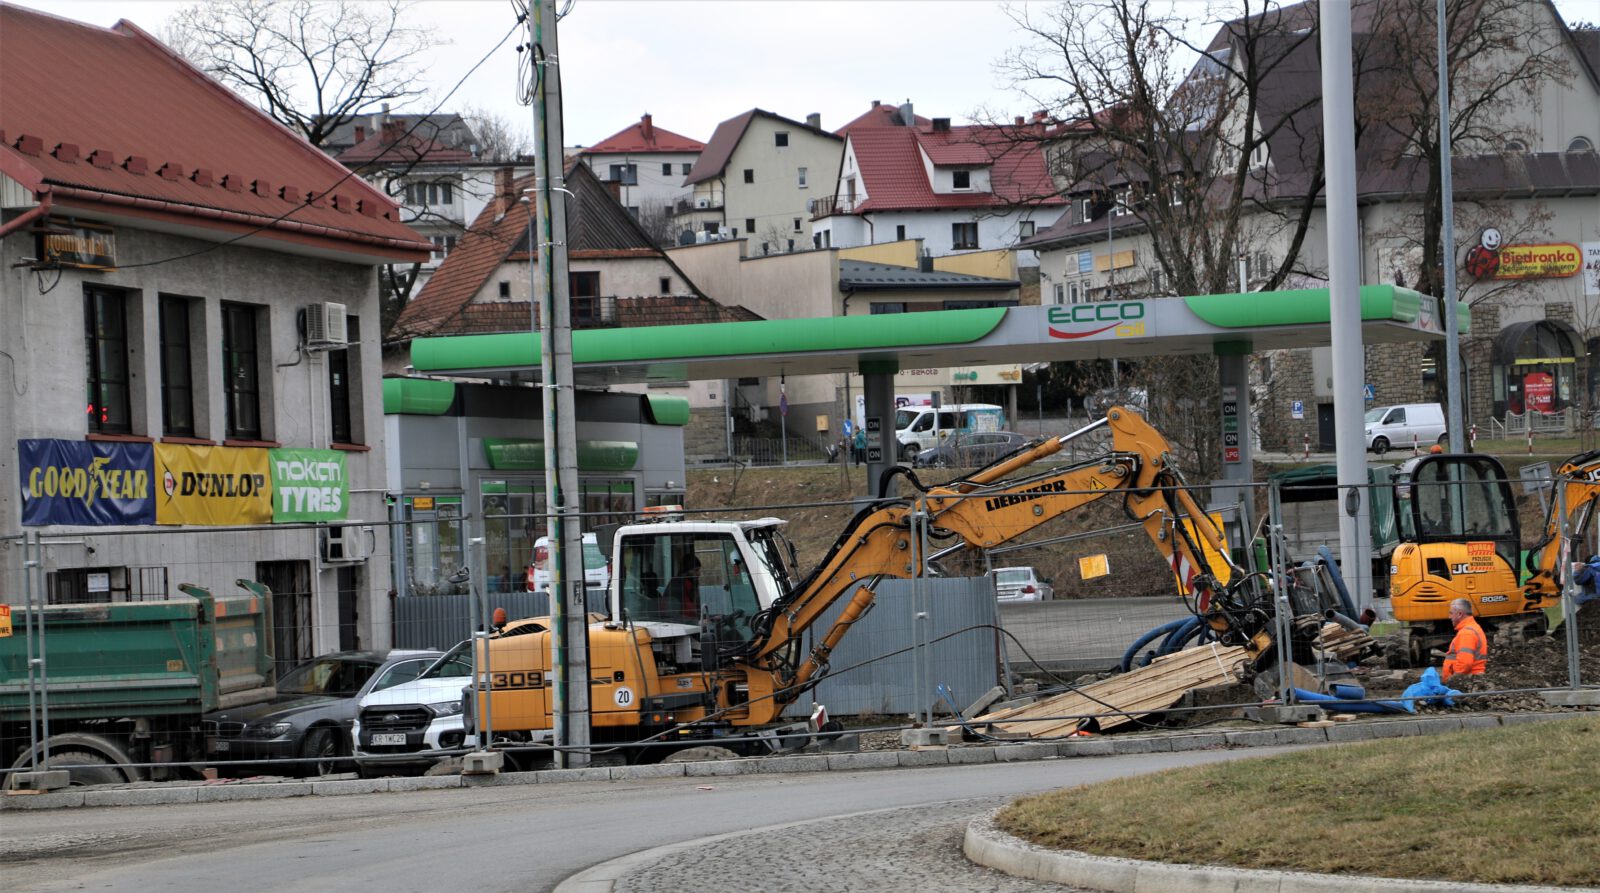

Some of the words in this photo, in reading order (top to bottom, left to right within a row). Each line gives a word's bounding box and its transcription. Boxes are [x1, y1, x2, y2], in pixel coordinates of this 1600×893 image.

[1502, 250, 1575, 264] Biedronka
[1048, 302, 1144, 324] ECCO
[1115, 321, 1145, 337] oil
[1224, 405, 1236, 413] ON
[1294, 402, 1301, 411] P
[868, 421, 879, 429] ON
[1225, 434, 1237, 442] ON
[869, 450, 881, 458] ON
[180, 472, 264, 498] DUNLOP
[279, 487, 342, 513] TYRES
[985, 480, 1067, 512] LIEBHERR
[494, 672, 542, 687] 309
[618, 690, 630, 703] 20
